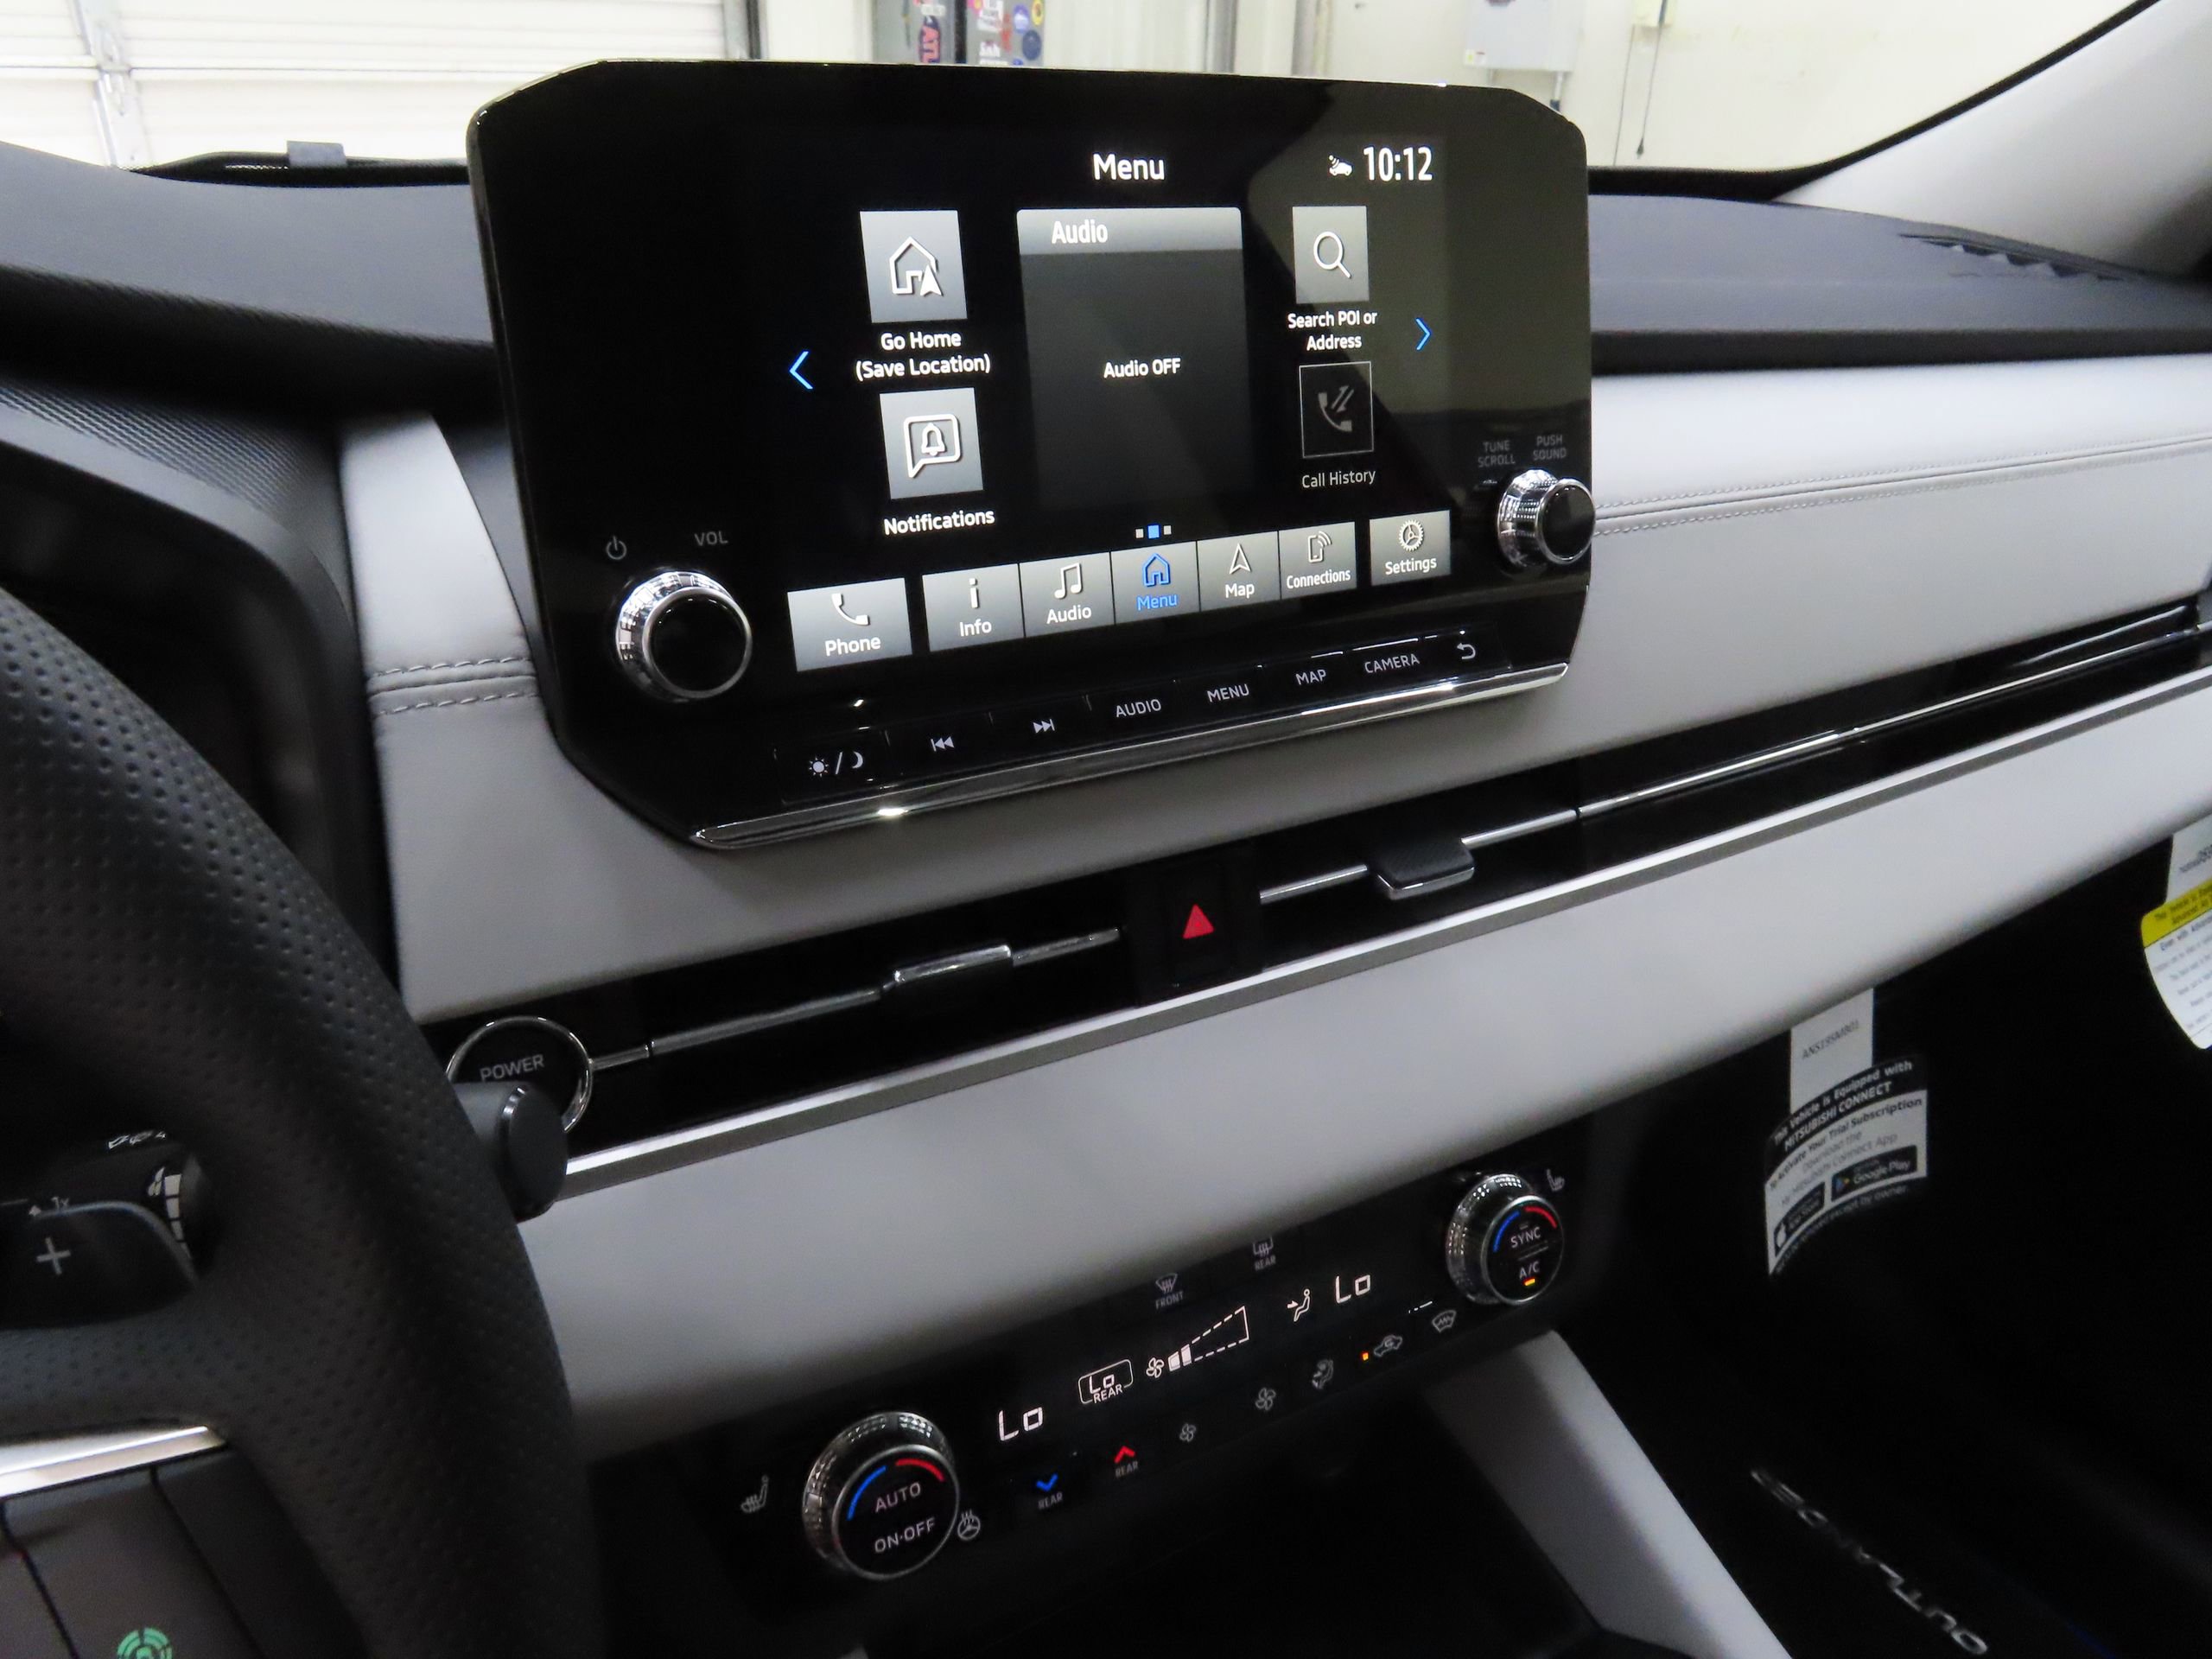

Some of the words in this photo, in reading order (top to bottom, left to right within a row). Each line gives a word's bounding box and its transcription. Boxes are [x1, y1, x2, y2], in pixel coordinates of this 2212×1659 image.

[1092, 153, 1165, 181] Menu
[1363, 146, 1433, 182] 10:12
[1052, 219, 1108, 244] Audio
[1287, 310, 1335, 329] Search
[1338, 309, 1361, 327] POI
[1363, 312, 1378, 325] or
[880, 332, 906, 351] Go
[909, 331, 962, 349] Home
[1306, 334, 1363, 351] Address
[855, 359, 906, 382] (Save
[910, 353, 991, 375] Location)
[1103, 359, 1149, 378] Audio
[1152, 357, 1181, 375] OFF
[1483, 439, 1510, 454] TUNE
[1536, 435, 1564, 448] PUSH
[1478, 453, 1516, 468] SCROLL
[1533, 446, 1567, 461] SOUND
[1301, 472, 1325, 489] Call
[1329, 470, 1376, 486] History
[883, 509, 995, 536] Notifications
[694, 531, 728, 547] VOL
[1384, 557, 1437, 575] Settings
[1286, 569, 1351, 589] Connections
[1224, 582, 1255, 599] Map
[1136, 593, 1179, 612] Menu
[1046, 604, 1092, 625] Audio
[959, 618, 992, 637] Info
[824, 637, 881, 657] Phone
[1364, 653, 1421, 674] CAMERA
[1295, 669, 1326, 685] MAP
[1206, 683, 1249, 702] MENU
[1116, 698, 1162, 718] AUDIO
[479, 1053, 545, 1084] POWER
[1789, 1101, 1821, 1127] Vehicle
[1822, 1095, 1831, 1105] is
[1834, 1068, 1881, 1103] Equipped
[1884, 1059, 1913, 1077] with
[1784, 1106, 1838, 1152] MITSUBISHI
[1838, 1080, 1893, 1115] CONNECT
[1808, 1136, 1827, 1154] Your
[1828, 1122, 1849, 1141] Trial
[1850, 1097, 1923, 1127] Subscription
[1875, 1133, 1898, 1148] App
[1852, 1166, 1887, 1185] Google
[1887, 1159, 1911, 1174] Play
[1510, 1226, 1541, 1249] SYNC
[1253, 1254, 1277, 1272] REAR
[1518, 1260, 1541, 1280] A/C
[1154, 1289, 1185, 1310] FRONT
[1092, 1382, 1125, 1404] REAR
[1115, 1460, 1139, 1478] REAR
[874, 1481, 922, 1514] AUTO
[1038, 1491, 1064, 1510] REAR
